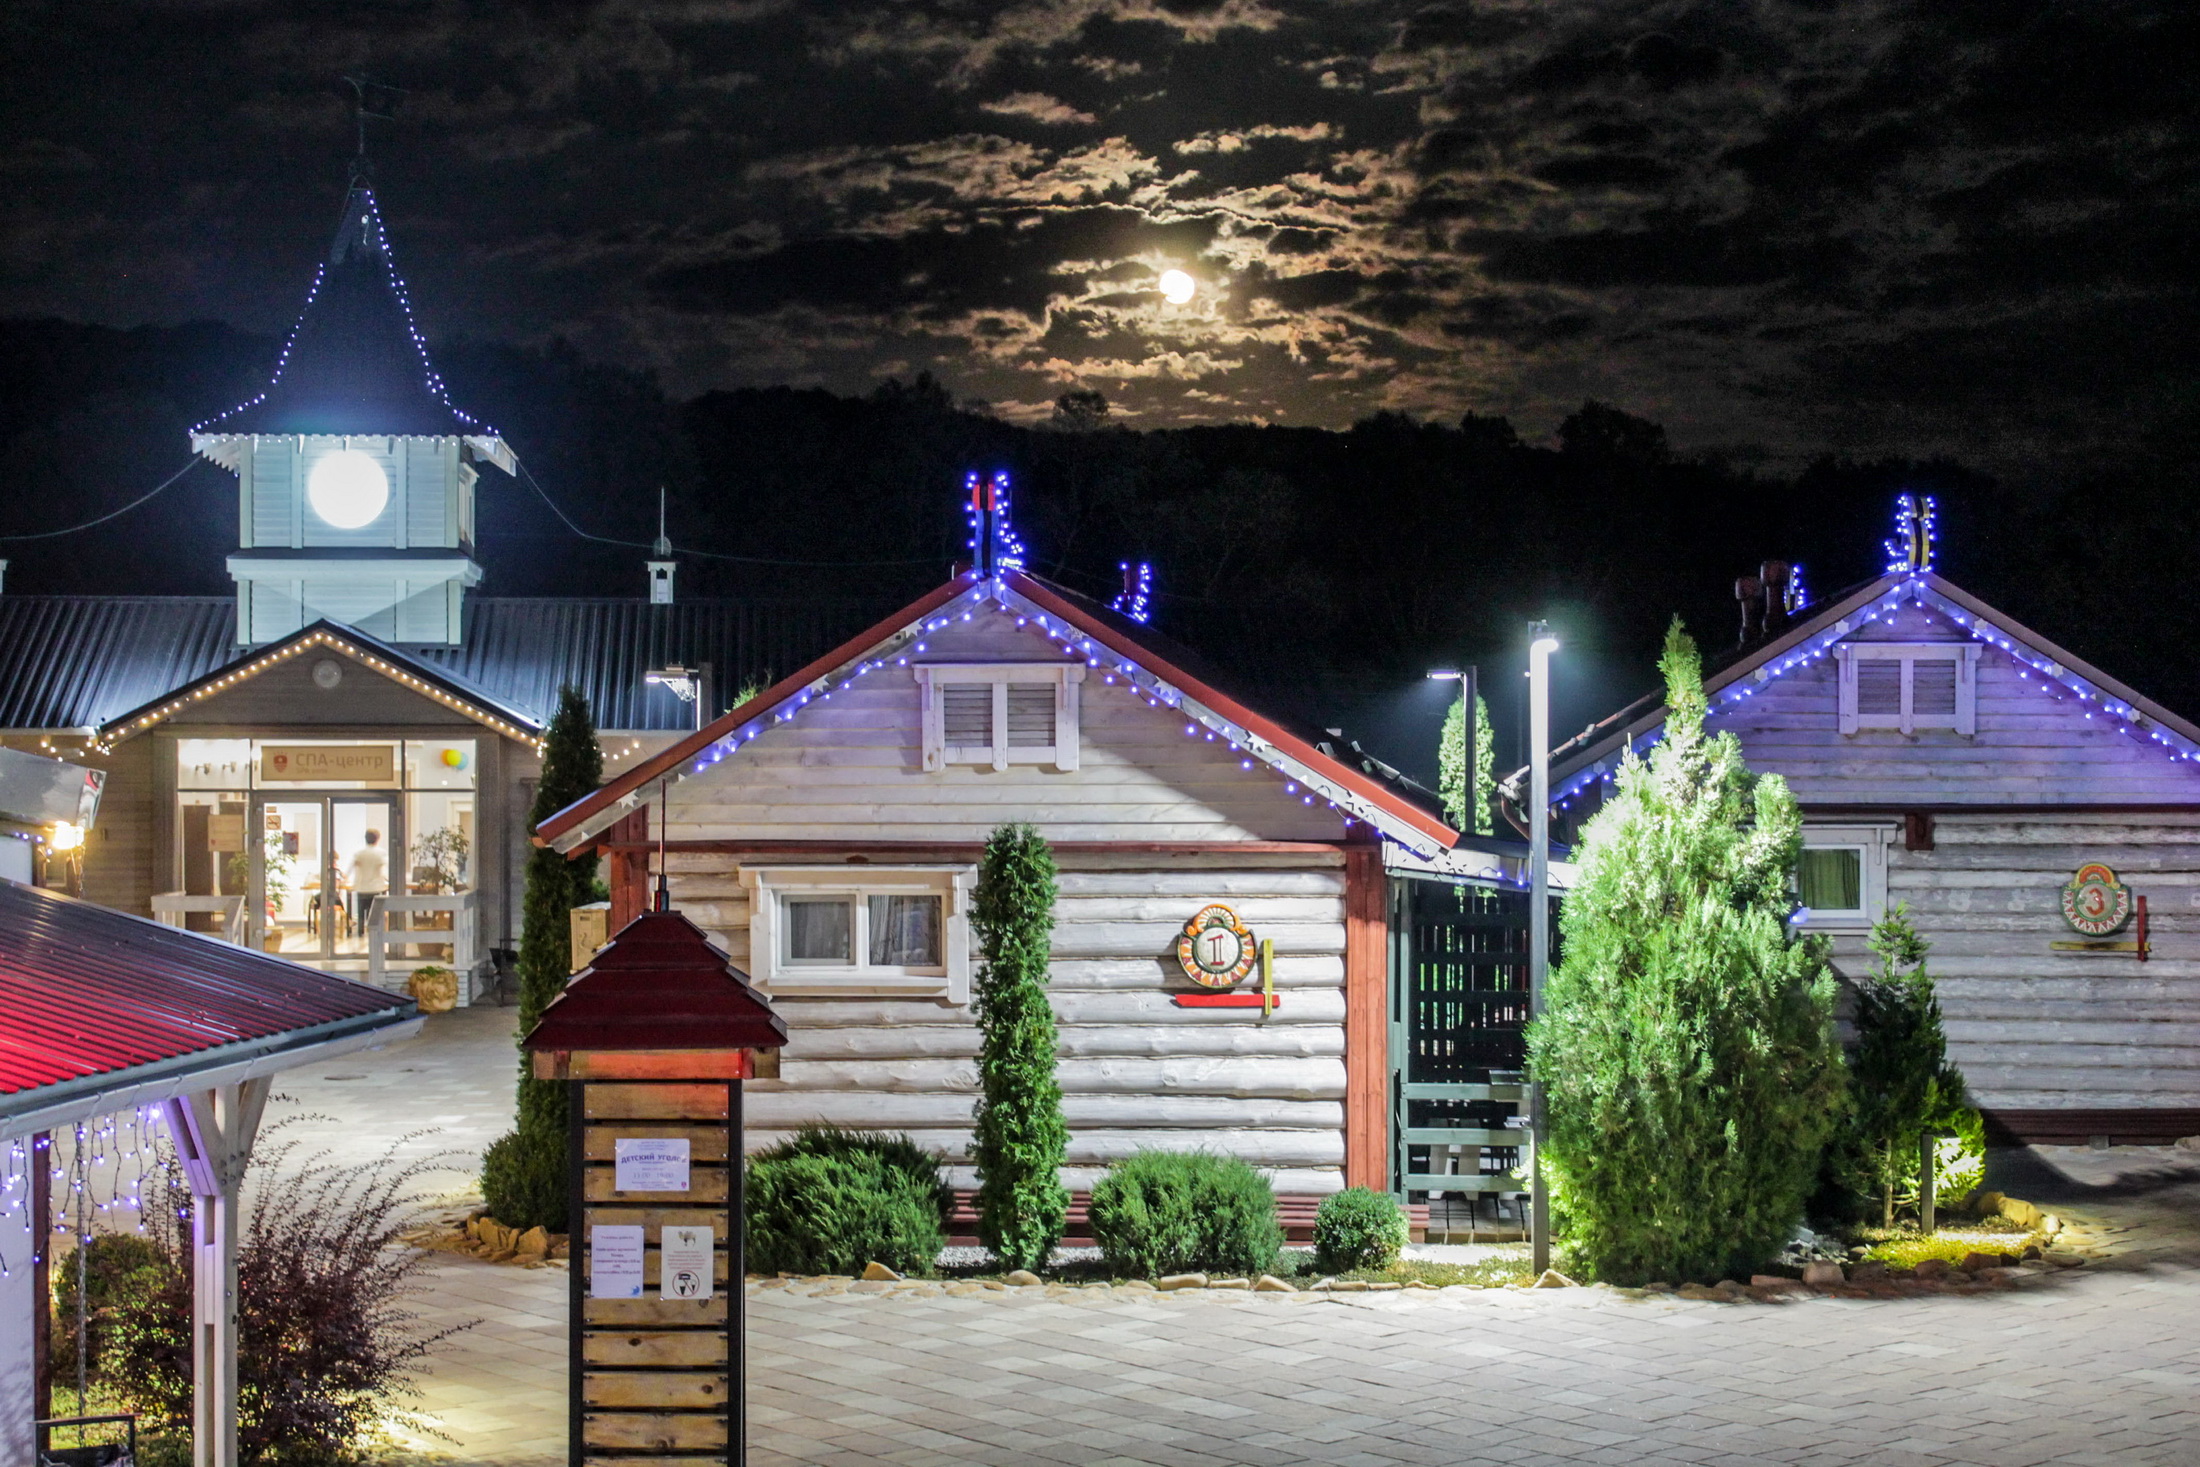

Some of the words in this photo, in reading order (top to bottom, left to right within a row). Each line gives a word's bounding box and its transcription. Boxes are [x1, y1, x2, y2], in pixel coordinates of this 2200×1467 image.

[296, 752, 383, 769] СПА-центр
[2086, 888, 2105, 916] 3
[1207, 933, 1225, 966] 1
[621, 1153, 654, 1164] ДЕТСКИЙ
